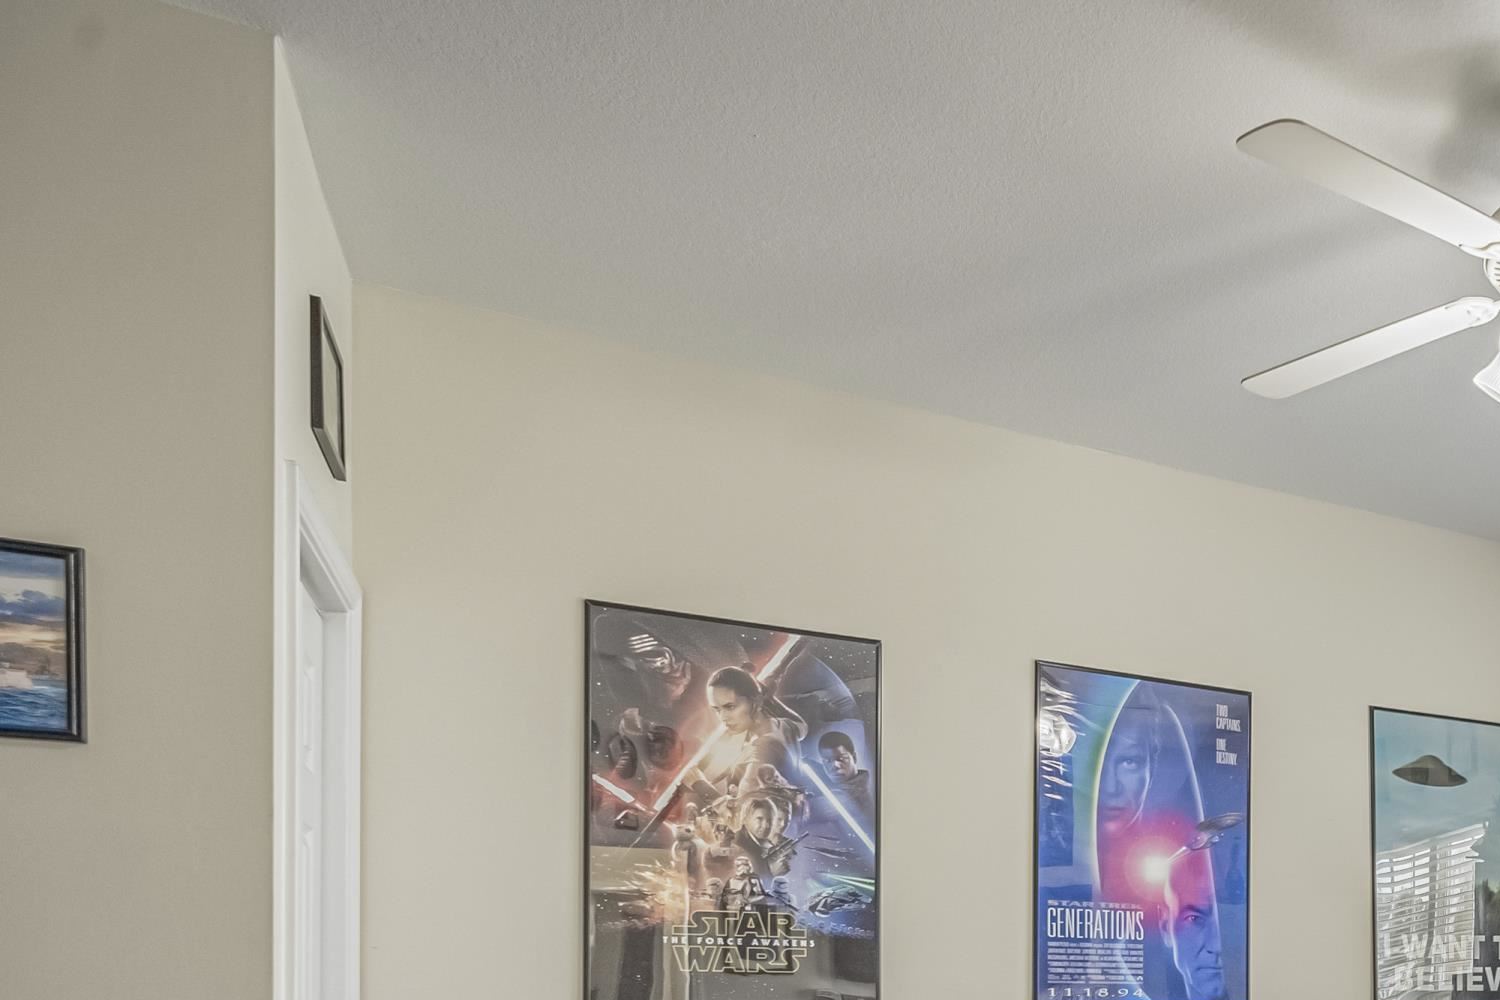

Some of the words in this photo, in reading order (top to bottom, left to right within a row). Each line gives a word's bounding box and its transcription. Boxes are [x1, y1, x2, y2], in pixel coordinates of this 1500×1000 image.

[672, 910, 807, 938] STAR
[1047, 907, 1144, 940] GENERATIONS
[662, 936, 687, 944] THE
[697, 937, 743, 946] FORCE
[751, 938, 815, 948] AWAKENS
[1383, 932, 1391, 957] I
[1401, 934, 1485, 960] WANT
[672, 945, 807, 973] WARS
[1047, 987, 1142, 997] 11.18.94
